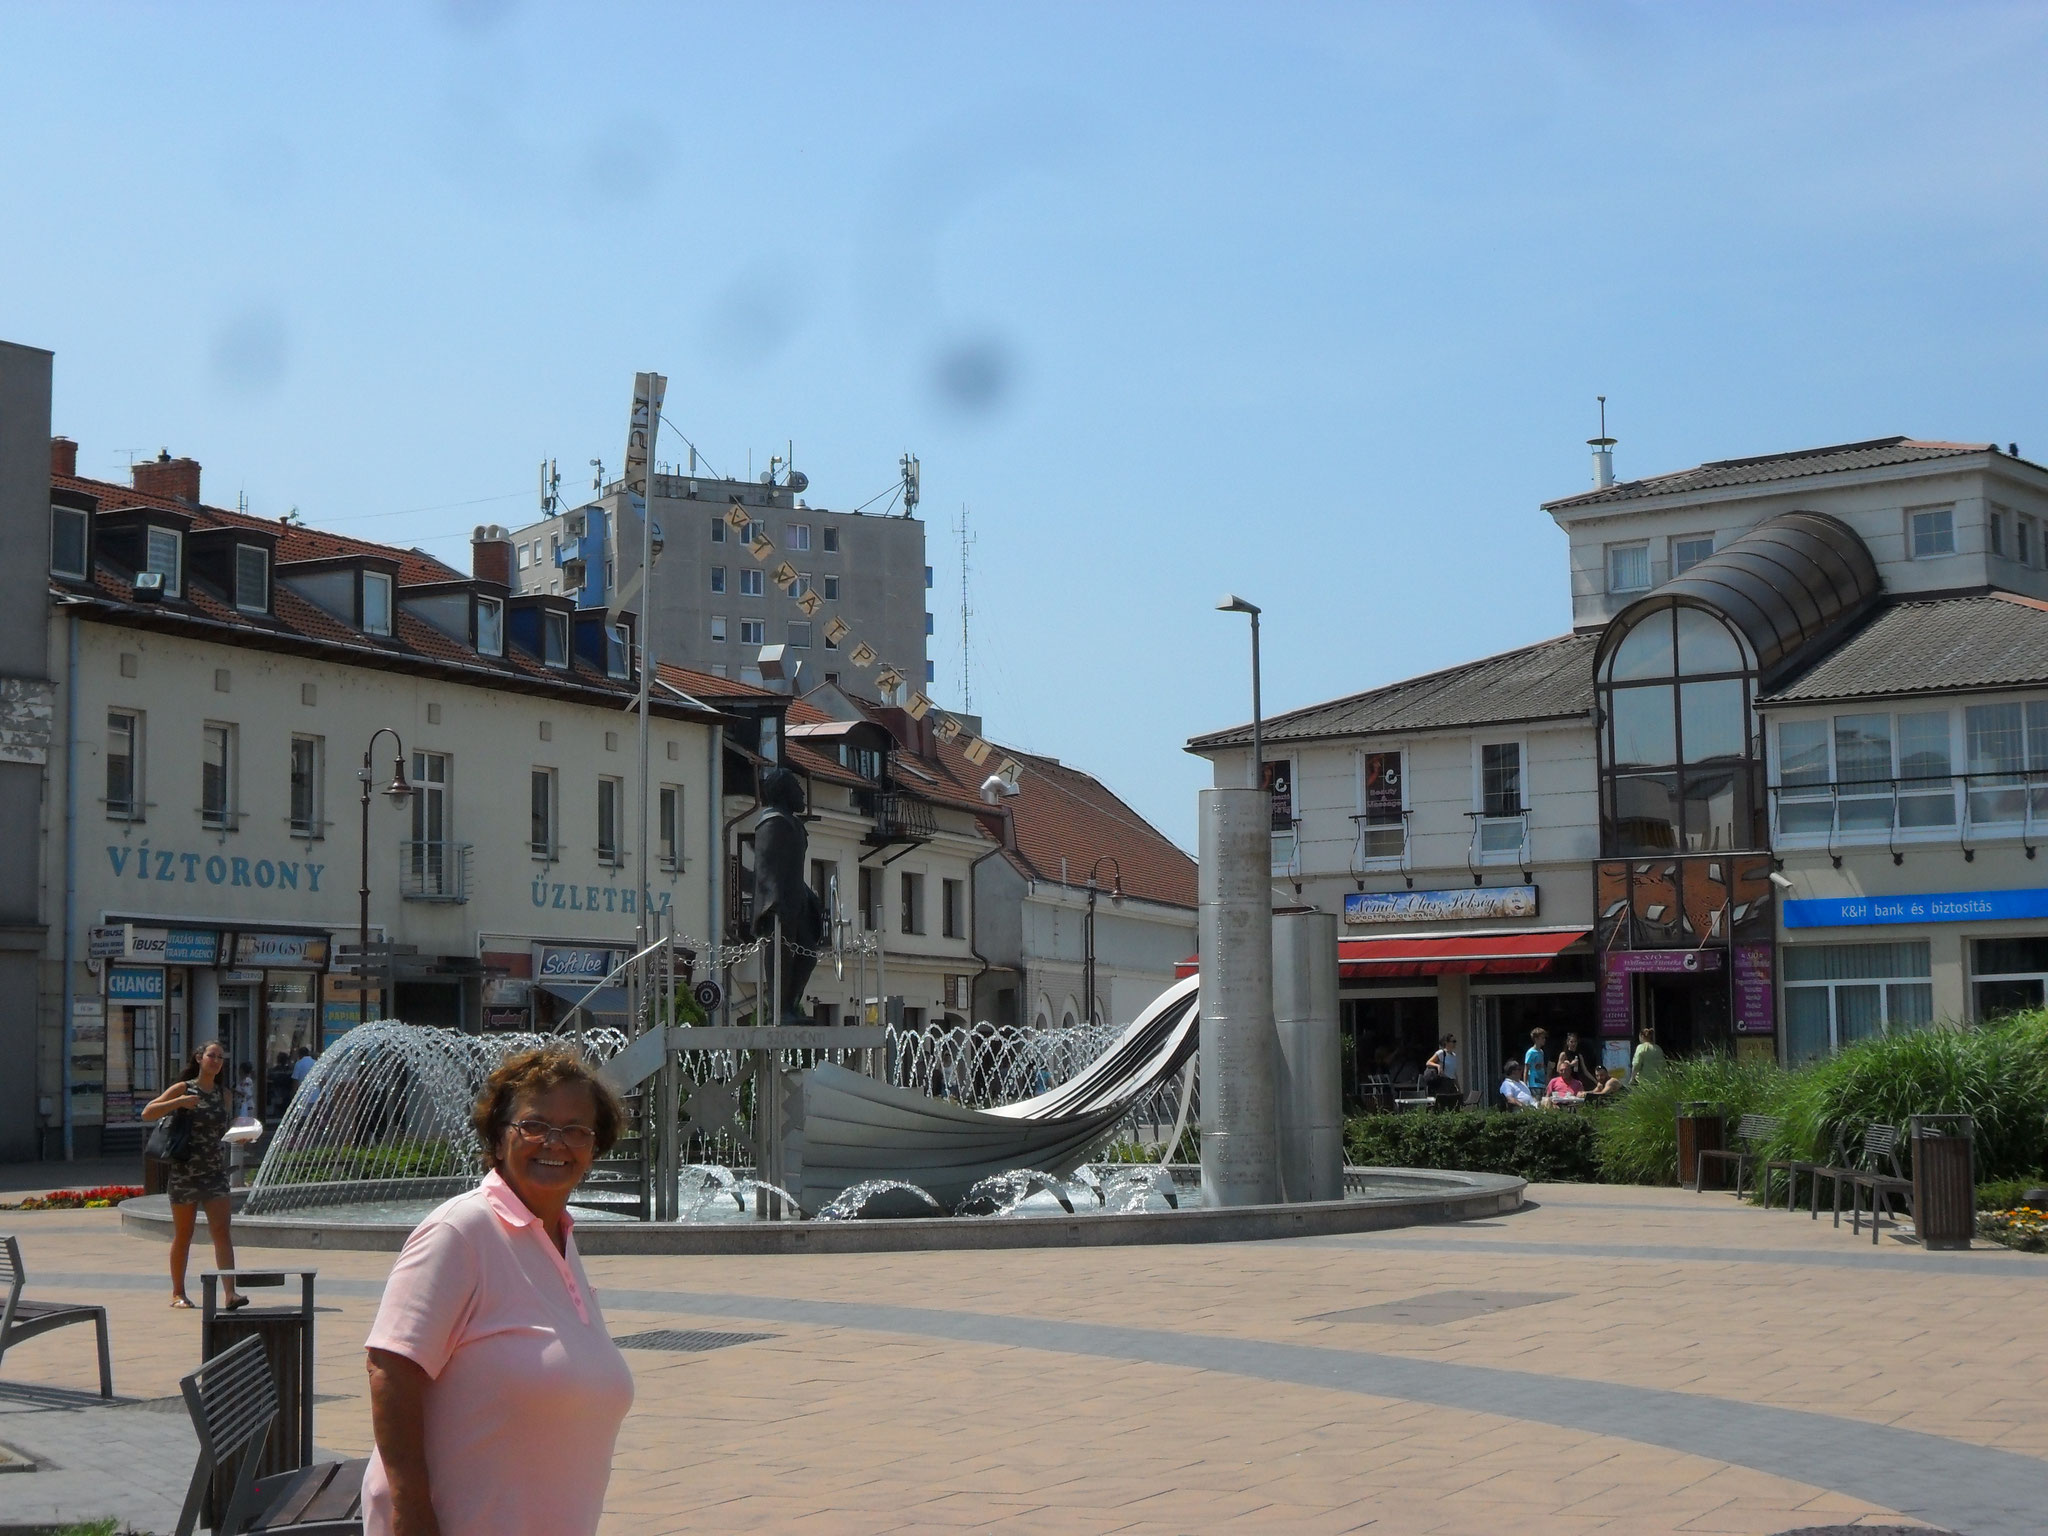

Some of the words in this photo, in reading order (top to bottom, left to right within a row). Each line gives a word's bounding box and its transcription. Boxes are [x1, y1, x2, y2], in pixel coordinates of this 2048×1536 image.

[106, 838, 325, 892] VÍZTORONY
[531, 873, 671, 916] ÜZLETHÁZ
[1841, 905, 1867, 918] K&H
[1874, 904, 1904, 916] bank
[1911, 902, 1924, 915] és
[1932, 899, 1993, 914] biztosítás
[166, 948, 189, 958] TRAVEL
[190, 949, 215, 959] AGENCY
[543, 951, 578, 974] Soft
[580, 953, 602, 972] Ice
[109, 975, 162, 993] CHANGE
